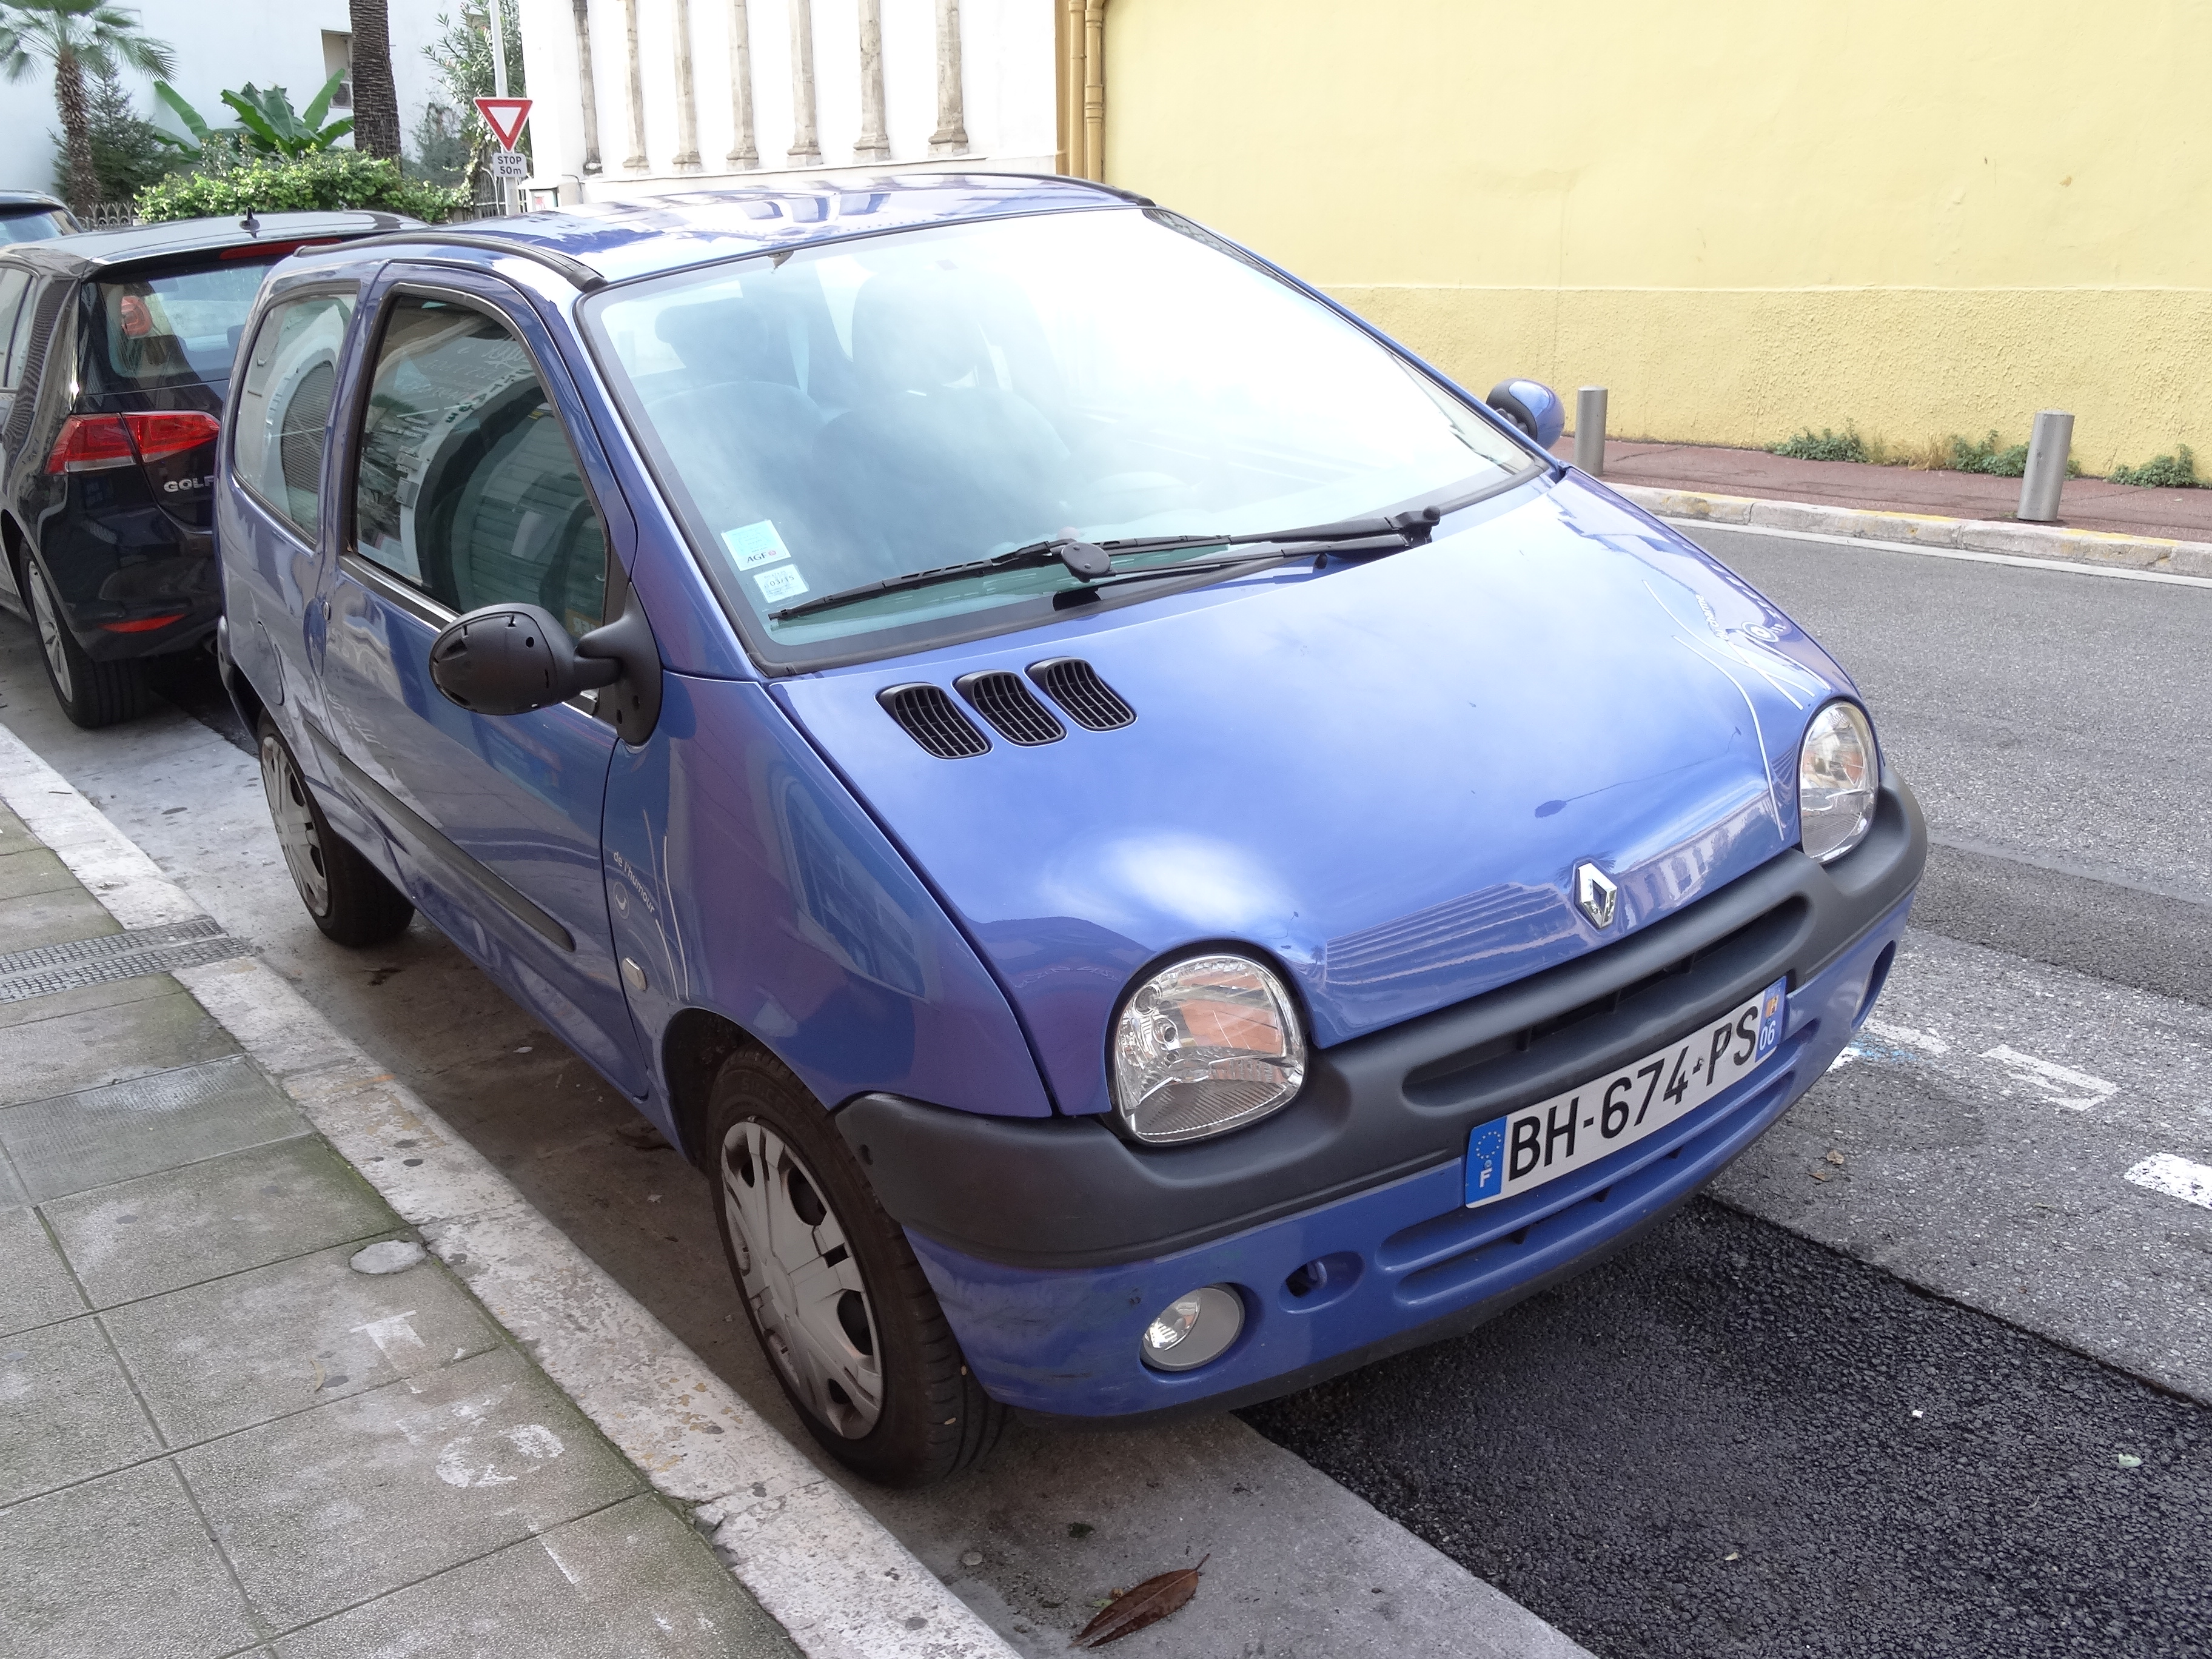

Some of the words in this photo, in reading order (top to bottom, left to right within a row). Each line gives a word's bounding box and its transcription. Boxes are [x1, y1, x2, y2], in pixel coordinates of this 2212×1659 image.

[498, 156, 522, 164] STOP
[500, 166, 521, 175] 50m
[164, 475, 214, 492] GOLF
[747, 552, 768, 564] AGF
[1715, 629, 1730, 640] du
[614, 851, 623, 866] de
[624, 862, 655, 913] l'humour
[1759, 1020, 1776, 1051] 06
[1508, 1005, 1758, 1182] BH-674-PS
[1479, 1168, 1493, 1188] F
